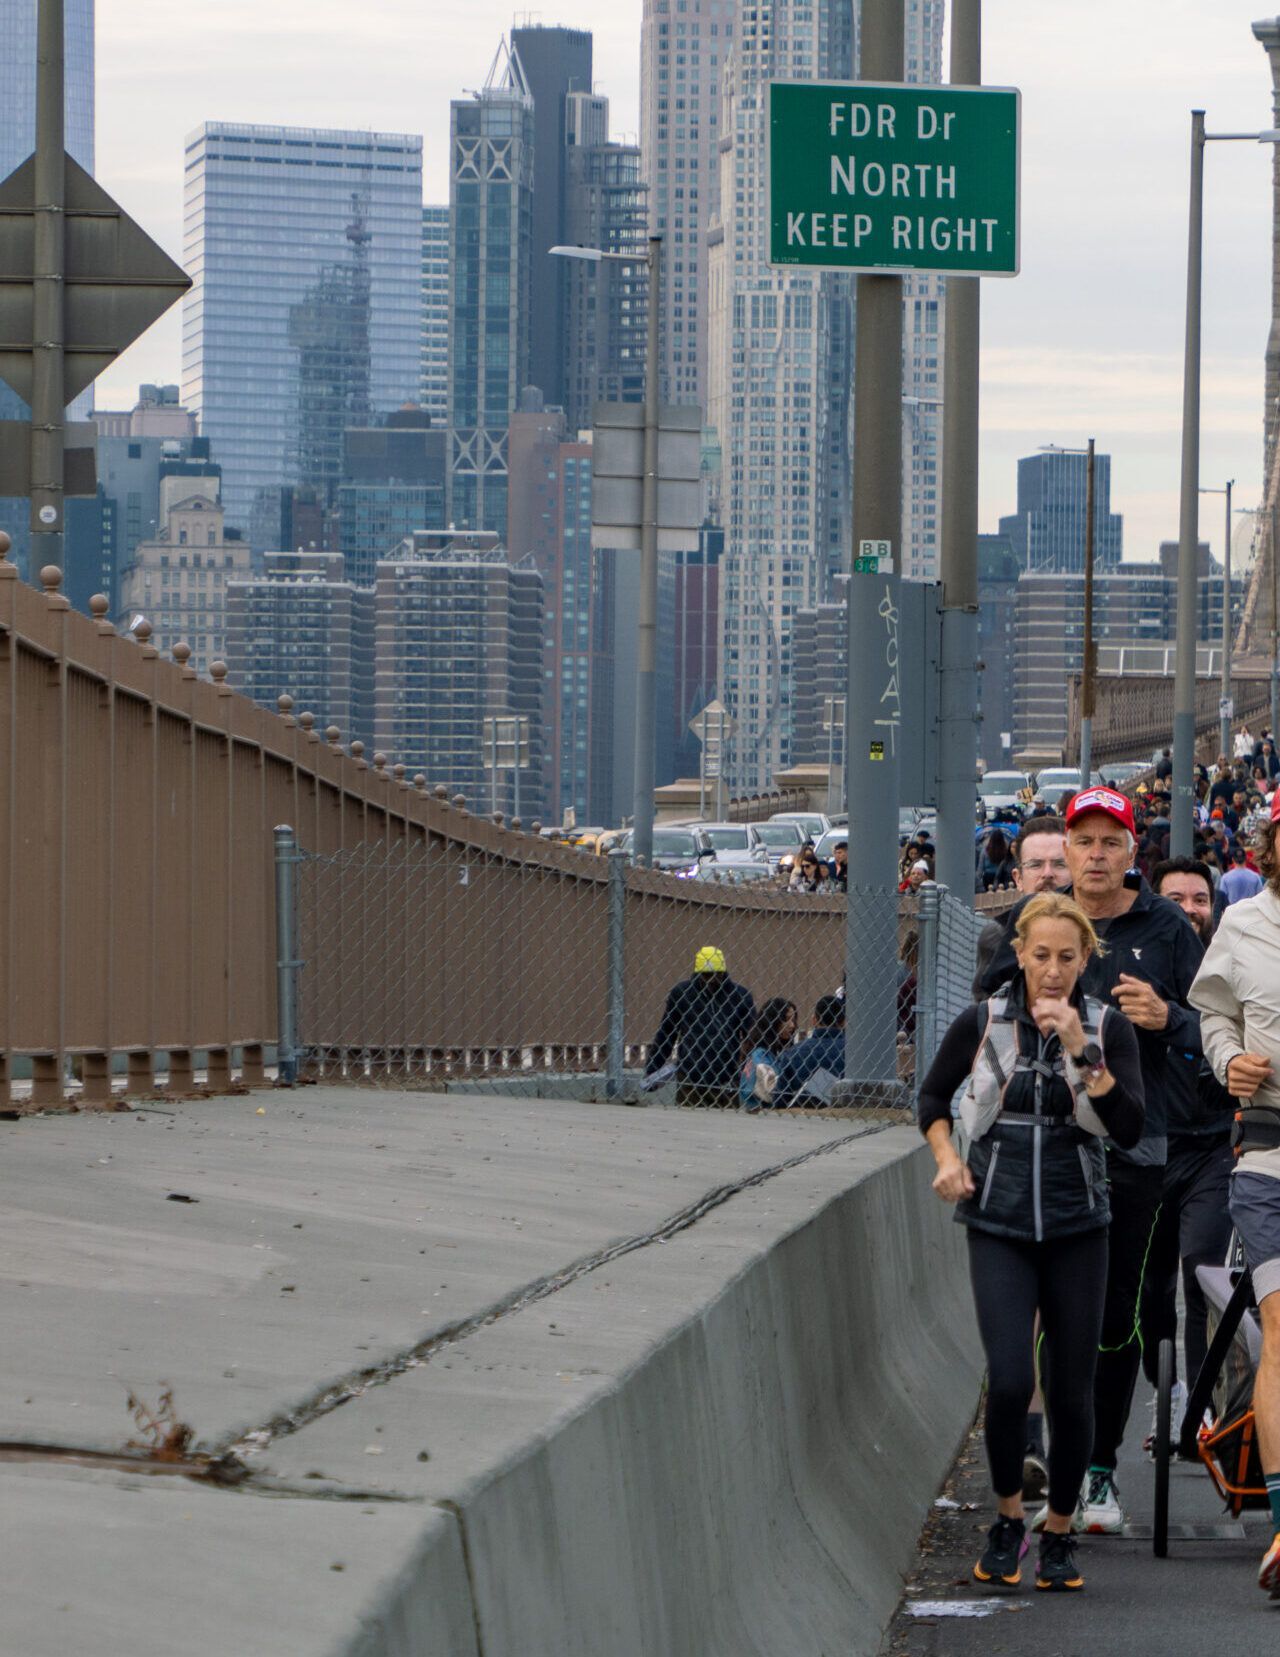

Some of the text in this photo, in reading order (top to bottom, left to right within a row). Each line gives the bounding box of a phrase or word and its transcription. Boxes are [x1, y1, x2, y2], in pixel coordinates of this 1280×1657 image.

[830, 102, 956, 140] FDR Dr
[830, 154, 956, 199] NORTH
[786, 211, 999, 252] KEEP RIGHT
